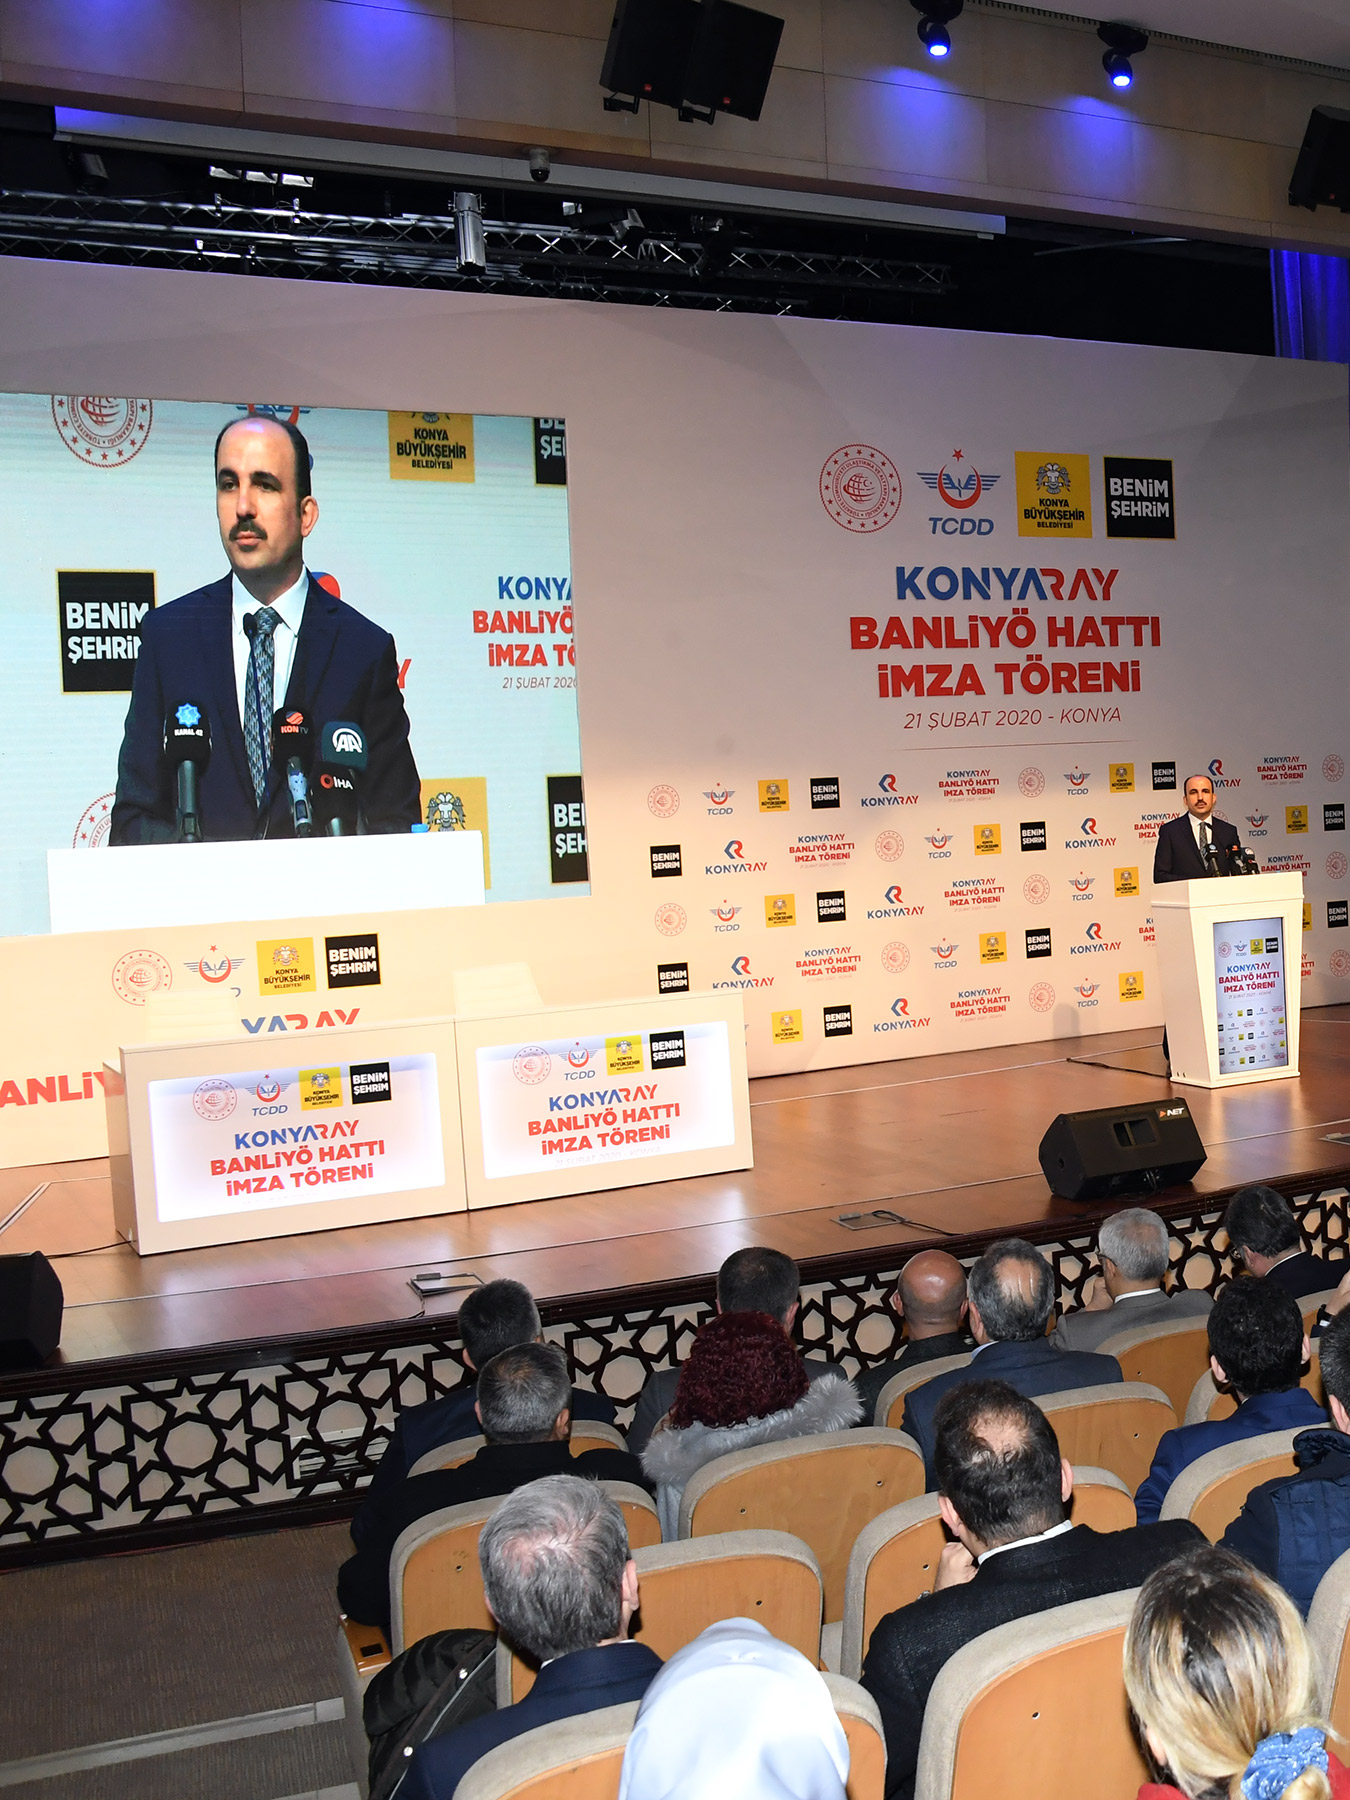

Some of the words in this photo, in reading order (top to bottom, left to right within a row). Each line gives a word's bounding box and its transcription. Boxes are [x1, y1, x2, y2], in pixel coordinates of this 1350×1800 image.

[414, 428, 449, 441] KONYA
[397, 439, 466, 459] BÜYÜKŞEHİR
[412, 459, 453, 469] BELEDİYESİ
[1038, 498, 1069, 508] KONYA
[1023, 506, 1085, 522] BÜYÜKŞEHİR
[928, 517, 994, 536] TCDD
[1037, 520, 1074, 529] BELEDİYESİ
[896, 566, 1119, 600] KONYARAY
[1047, 616, 1161, 647] HATTI
[502, 677, 513, 689] 21
[516, 677, 551, 689] ŞUBAT
[904, 712, 922, 729] 21
[928, 711, 991, 730] ŞUBAT
[996, 709, 1042, 726] 2020
[1060, 707, 1121, 724] KONYA
[947, 770, 991, 778] KONYARAY
[976, 778, 1000, 786] HATTI
[861, 796, 919, 807] KONYARAY
[798, 834, 845, 843] KONYARAY
[1248, 829, 1267, 837] TCDD
[829, 842, 855, 851] HATTI
[1066, 838, 1116, 849] KONYARAY
[928, 851, 951, 859] TCDD
[1268, 854, 1303, 863] KONYARAY
[706, 862, 768, 875] KONYARAY
[1291, 862, 1310, 870] HATTI
[952, 878, 996, 887] KONYARAY
[981, 886, 1004, 895] HATTI
[1072, 893, 1093, 901] TCDD
[868, 906, 924, 919] KONYARAY
[714, 924, 740, 932] TCDD
[805, 946, 851, 957] KONYARAY
[1071, 942, 1121, 955] KONYARAY
[836, 955, 861, 965] HATTI
[1227, 962, 1271, 973] KONYARAY
[1256, 971, 1279, 980] HATTI
[958, 988, 1001, 998] KONYARAY
[987, 996, 1010, 1004] HATTI
[874, 1018, 931, 1032] KONYARAY
[564, 1070, 596, 1081] TCDD
[549, 1084, 658, 1112] KONYARAY
[252, 1105, 288, 1117] TCDD
[622, 1103, 680, 1122] HATTI
[1167, 1108, 1185, 1116] NET
[235, 1120, 359, 1149] KONYARAY
[319, 1140, 385, 1162] HATTI
